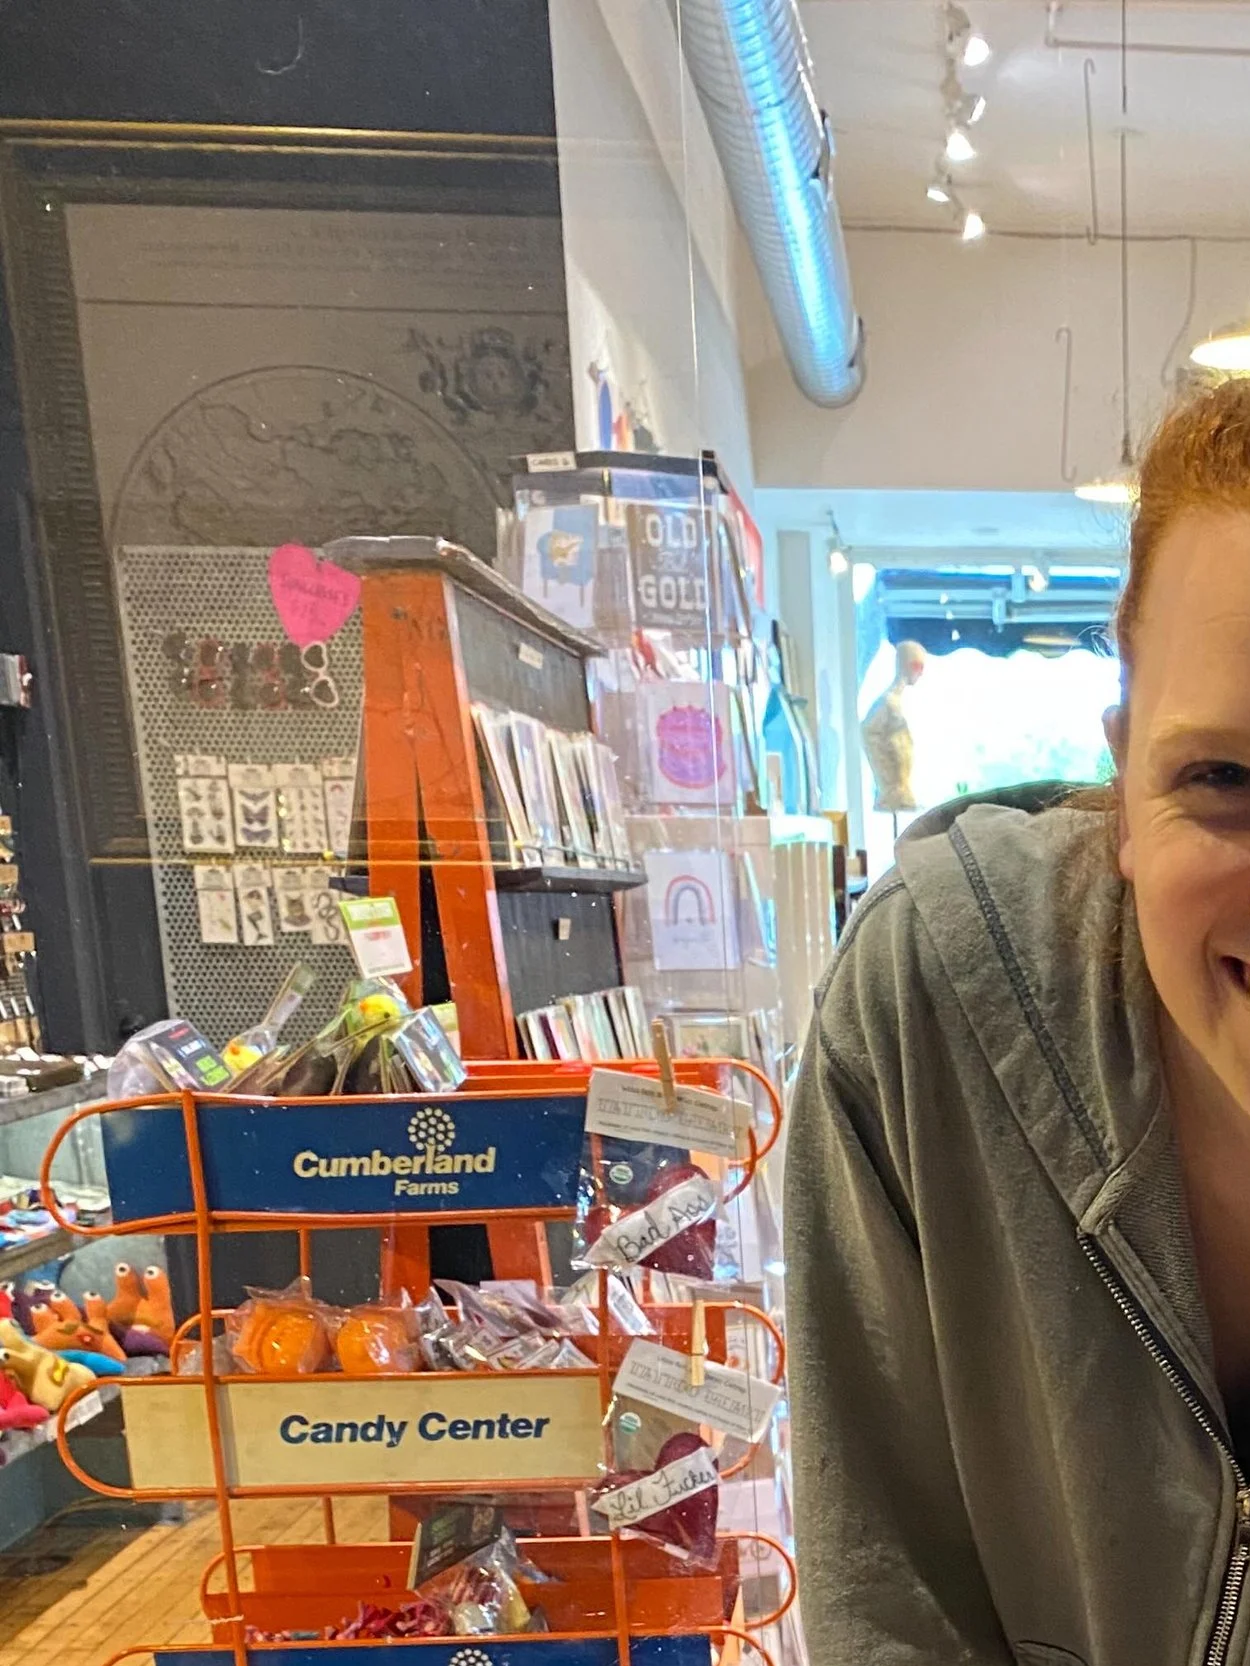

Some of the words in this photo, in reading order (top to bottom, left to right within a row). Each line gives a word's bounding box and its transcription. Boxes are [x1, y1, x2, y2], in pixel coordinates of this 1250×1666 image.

[645, 512, 697, 549] OLD
[293, 1146, 496, 1178] Cumberland
[394, 1179, 459, 1196] Farms
[617, 1210, 671, 1263] Bad
[280, 1414, 407, 1448] Candy
[418, 1412, 550, 1441] Center
[610, 1491, 648, 1521] Lil
[652, 1469, 714, 1505] Fucker
